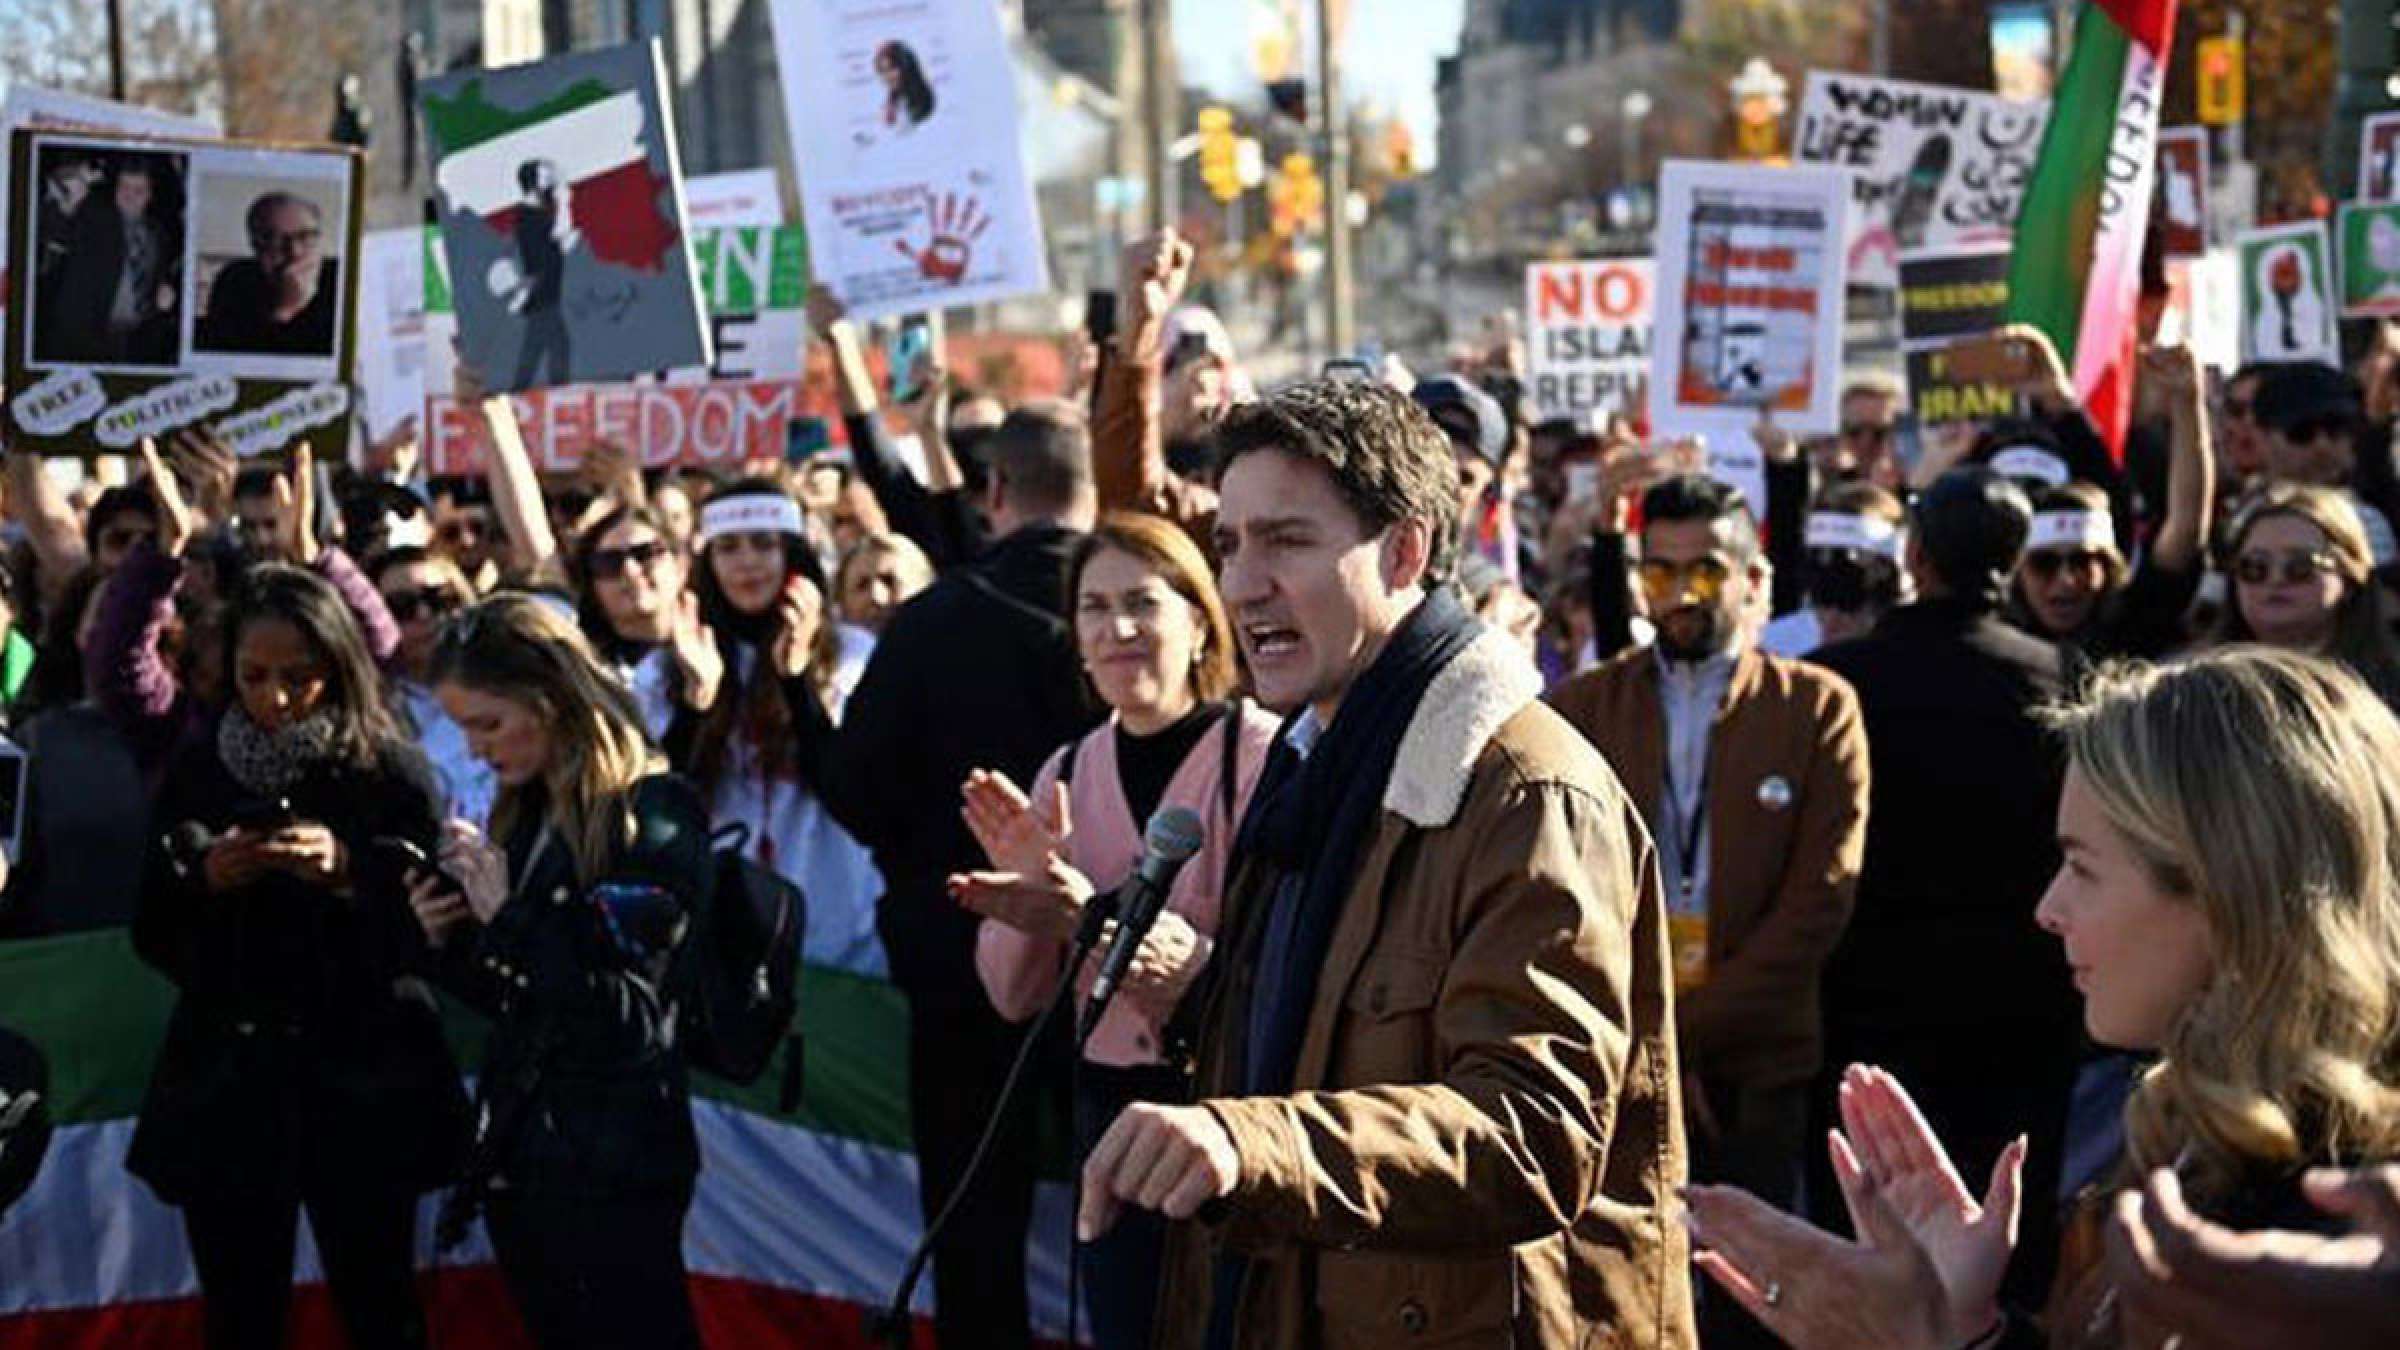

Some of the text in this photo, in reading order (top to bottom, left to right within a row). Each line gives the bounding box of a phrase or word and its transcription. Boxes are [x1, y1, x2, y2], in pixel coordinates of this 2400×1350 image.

[1538, 269, 1645, 320] NO
[1546, 325, 1653, 361] ISLA
[25, 380, 88, 419] FREE
[106, 378, 226, 431] POLITICAL
[1920, 384, 2012, 422] IRAN
[430, 382, 797, 473] FEEDOM
